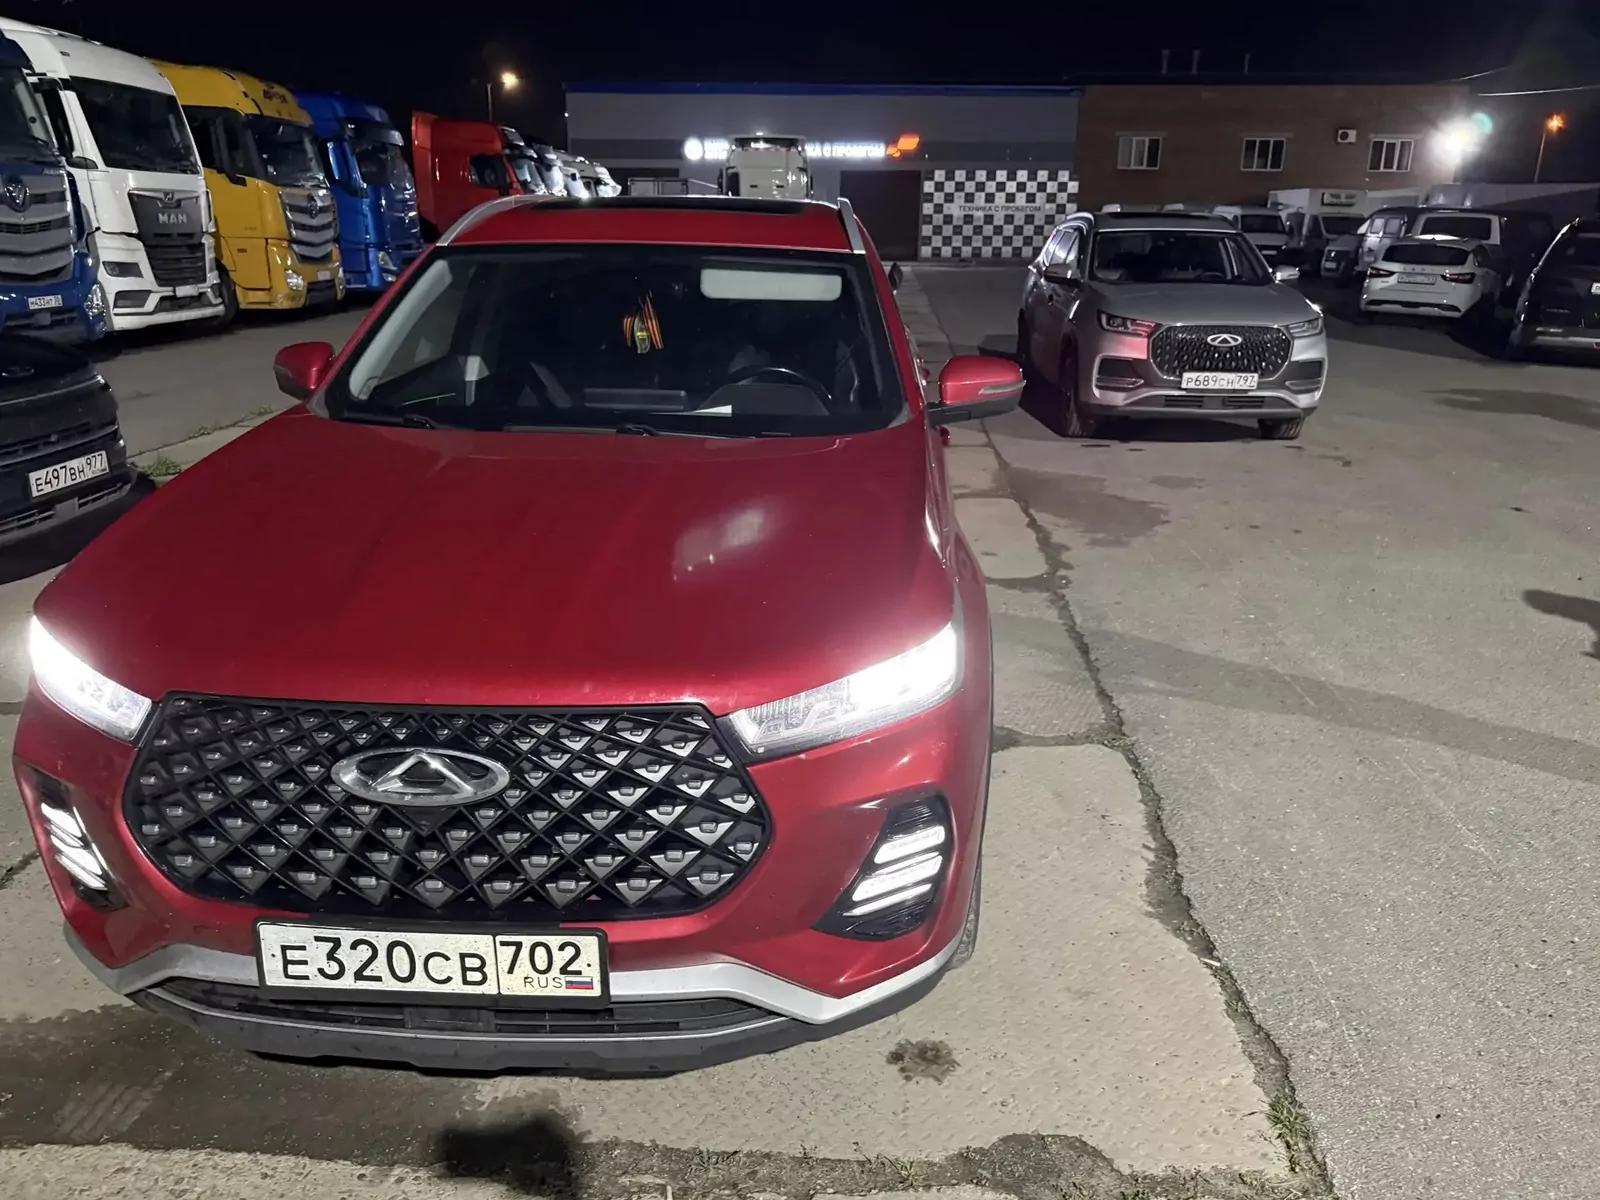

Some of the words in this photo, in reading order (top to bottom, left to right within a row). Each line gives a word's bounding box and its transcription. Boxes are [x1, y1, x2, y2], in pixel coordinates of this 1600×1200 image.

[958, 205, 992, 213] ТЕХНИКА
[994, 205, 1000, 213] С
[1001, 205, 1041, 213] ПРОБЕГОМ
[158, 212, 187, 224] MAN
[1186, 374, 1234, 387] Р689СН
[35, 465, 86, 493] Е497ВН
[85, 453, 104, 471] 977
[280, 935, 488, 987] Е320СВ
[499, 941, 583, 976] 702
[523, 976, 563, 989] RUS
